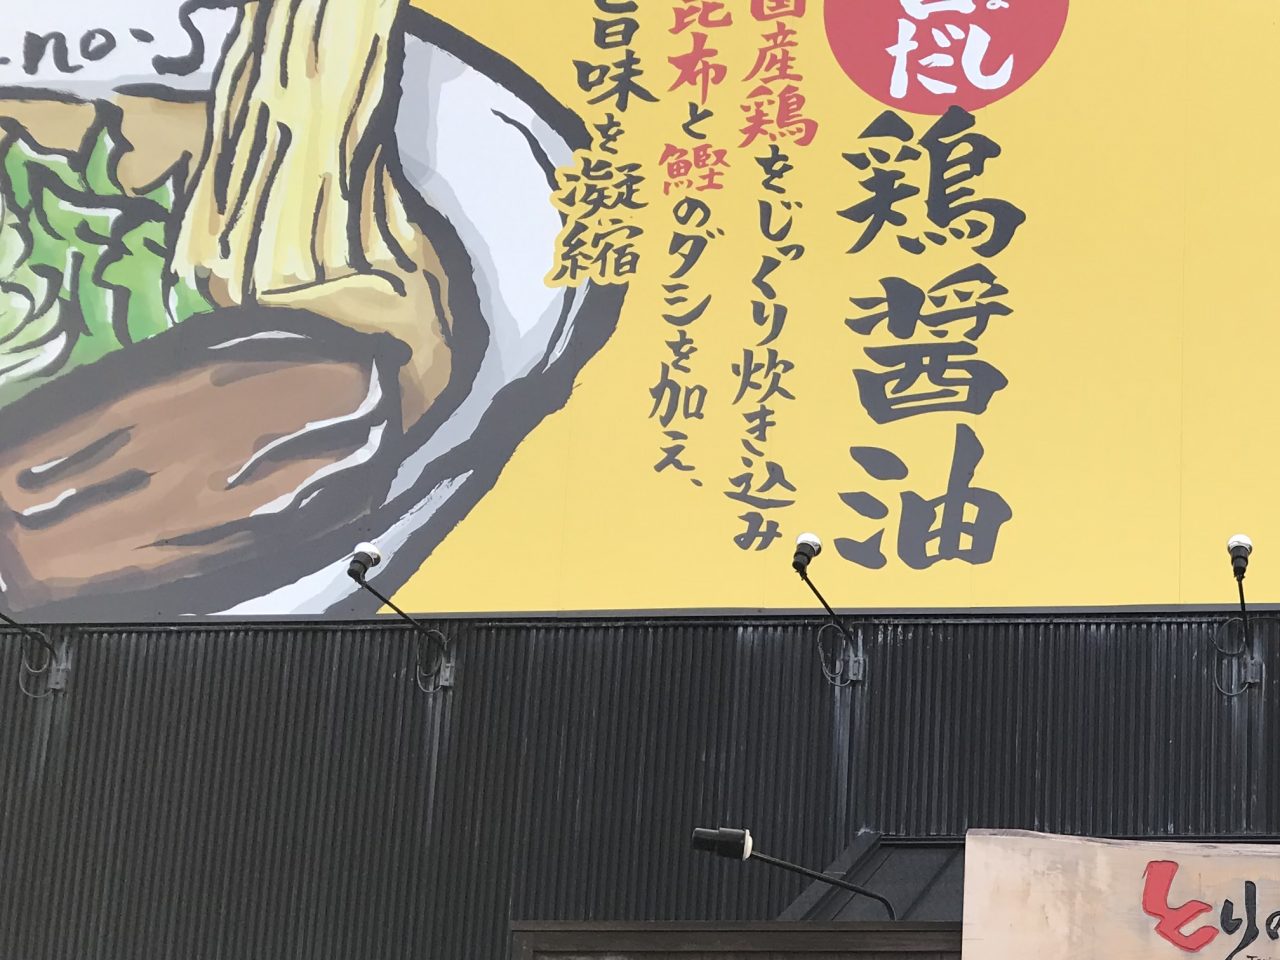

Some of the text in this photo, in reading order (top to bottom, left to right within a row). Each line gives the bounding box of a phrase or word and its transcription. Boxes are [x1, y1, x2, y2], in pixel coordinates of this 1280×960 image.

[551, 0, 660, 281] 旨味を凝縮
[885, 18, 1014, 99] だし
[834, 105, 1027, 570] 鶏醤油
